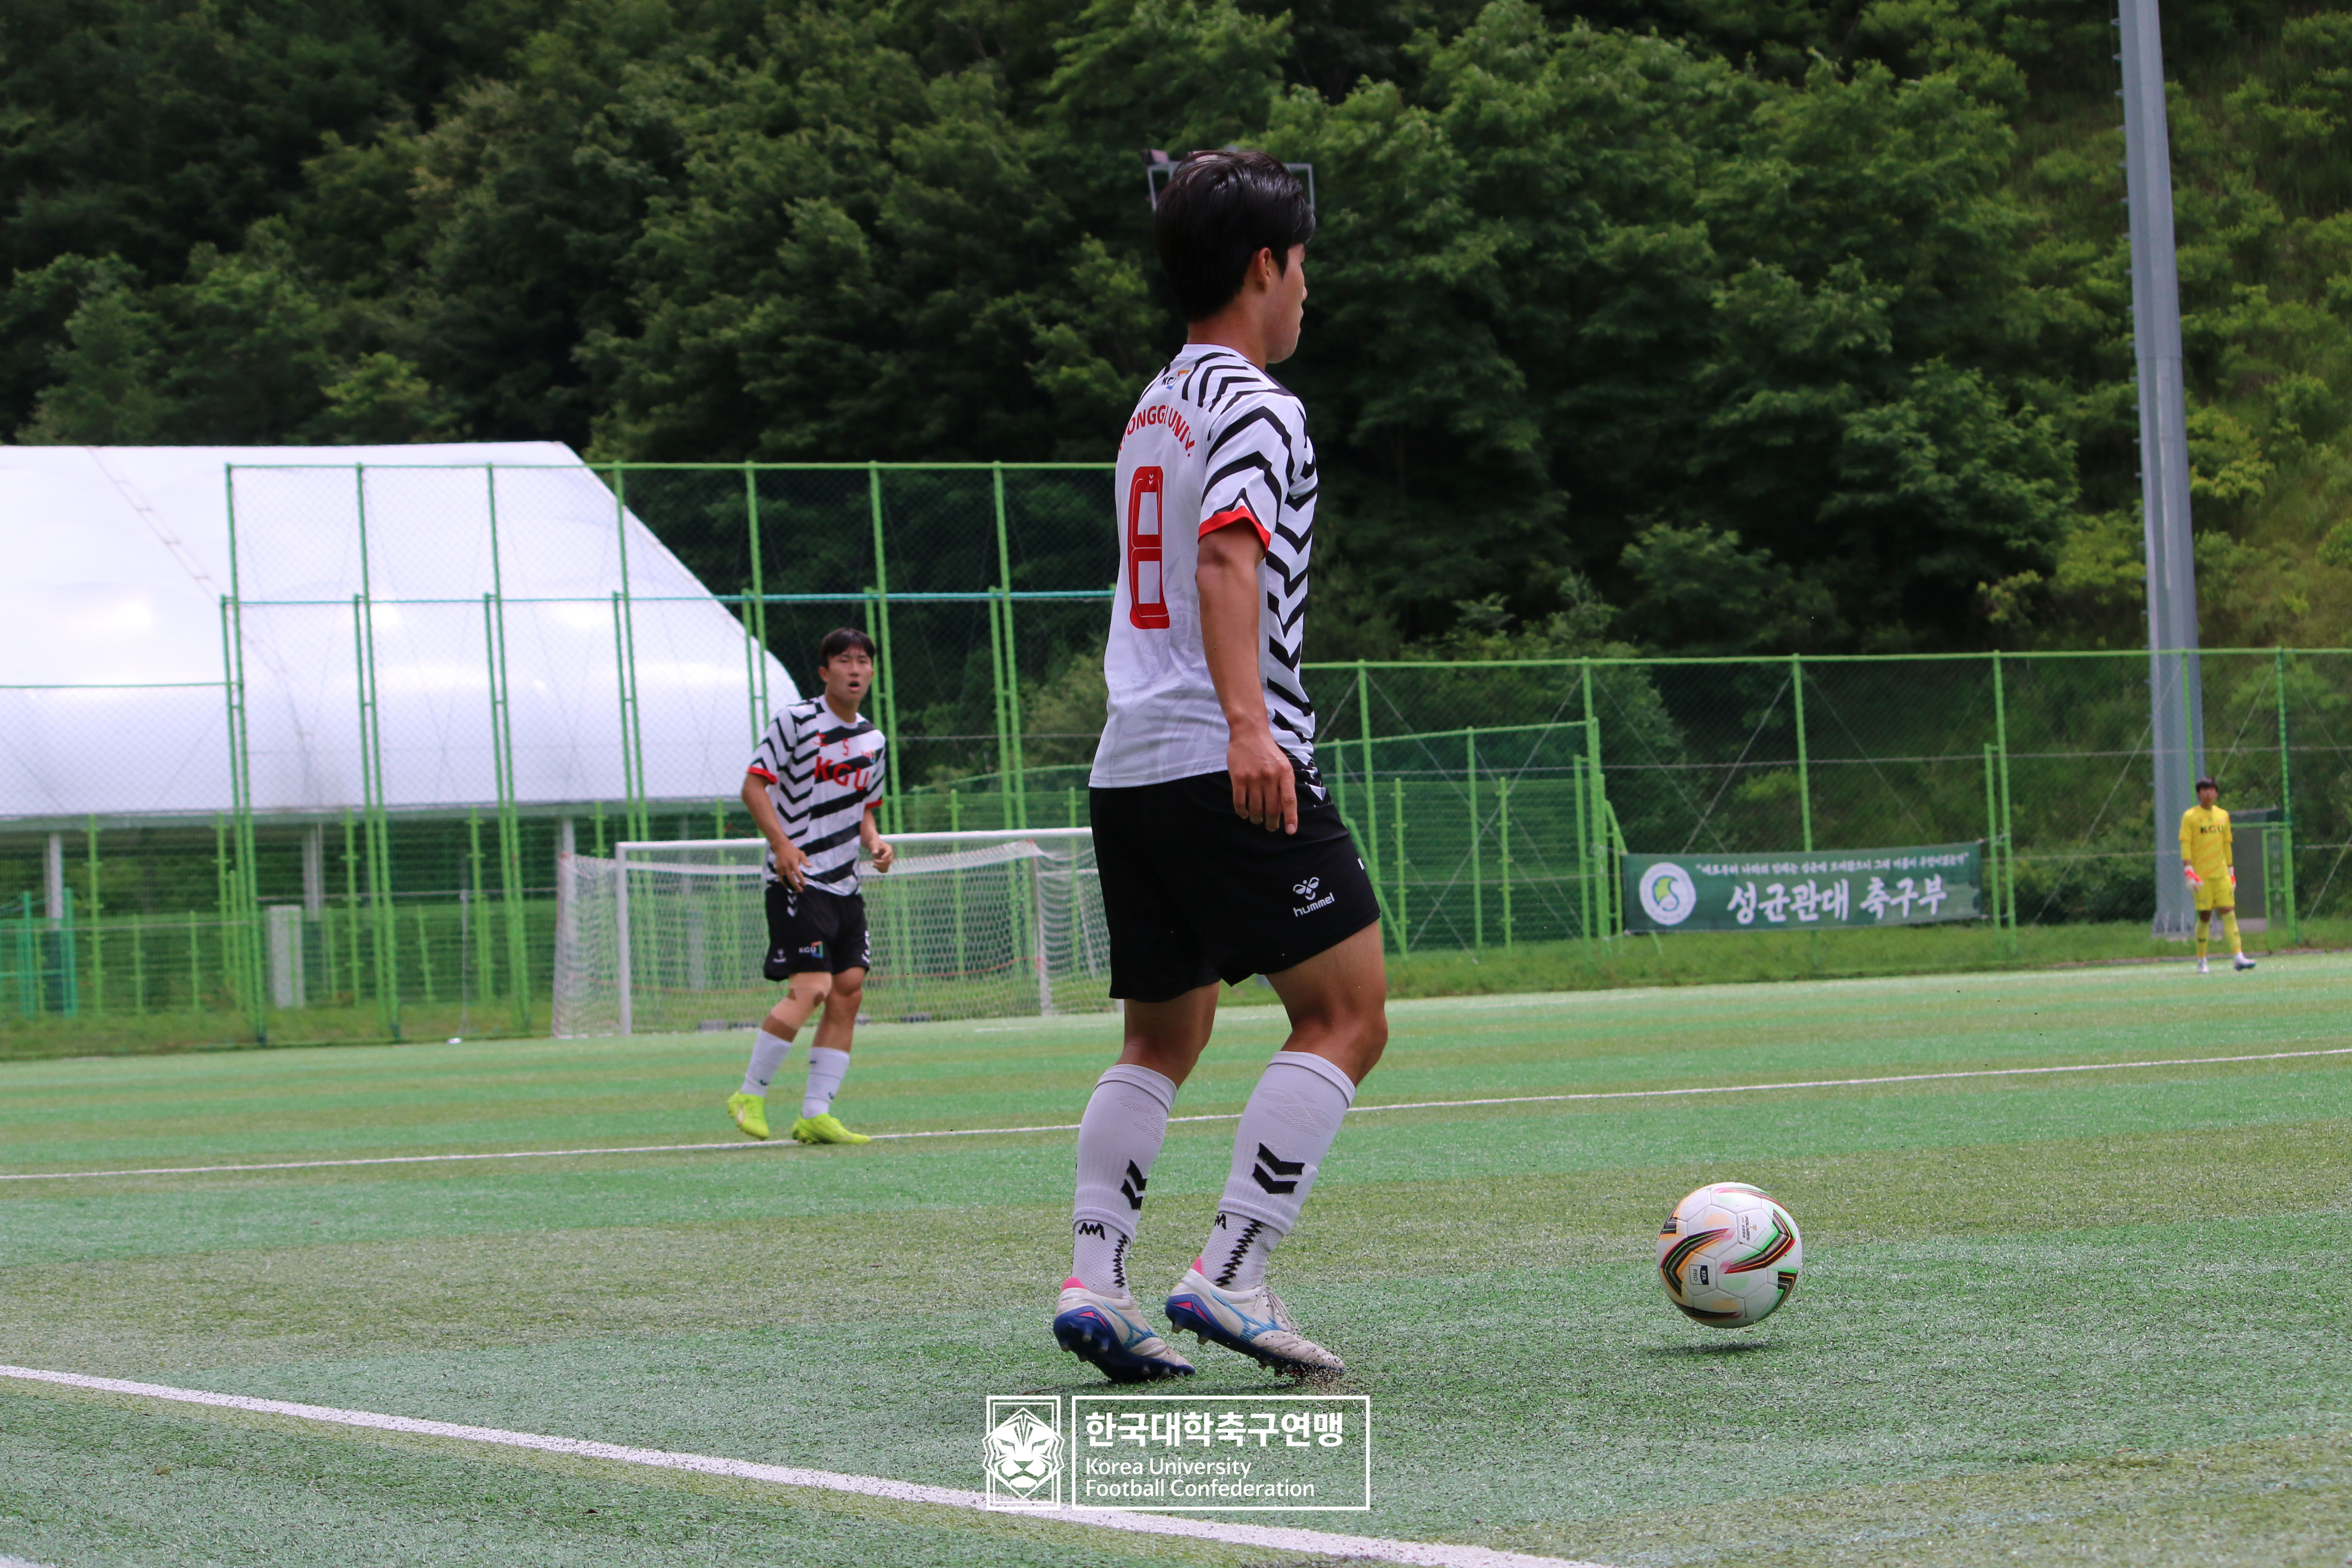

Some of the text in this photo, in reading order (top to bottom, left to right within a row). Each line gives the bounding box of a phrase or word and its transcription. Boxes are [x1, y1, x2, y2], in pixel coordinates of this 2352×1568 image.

[1168, 408, 1195, 457] UNIV.
[1127, 466, 1170, 629] 8
[814, 756, 870, 791] KGU
[2200, 825, 2223, 833] KGU
[1293, 892, 1335, 917] hummel
[1727, 878, 1850, 925] 성균관대
[1860, 873, 1948, 920] 축구부
